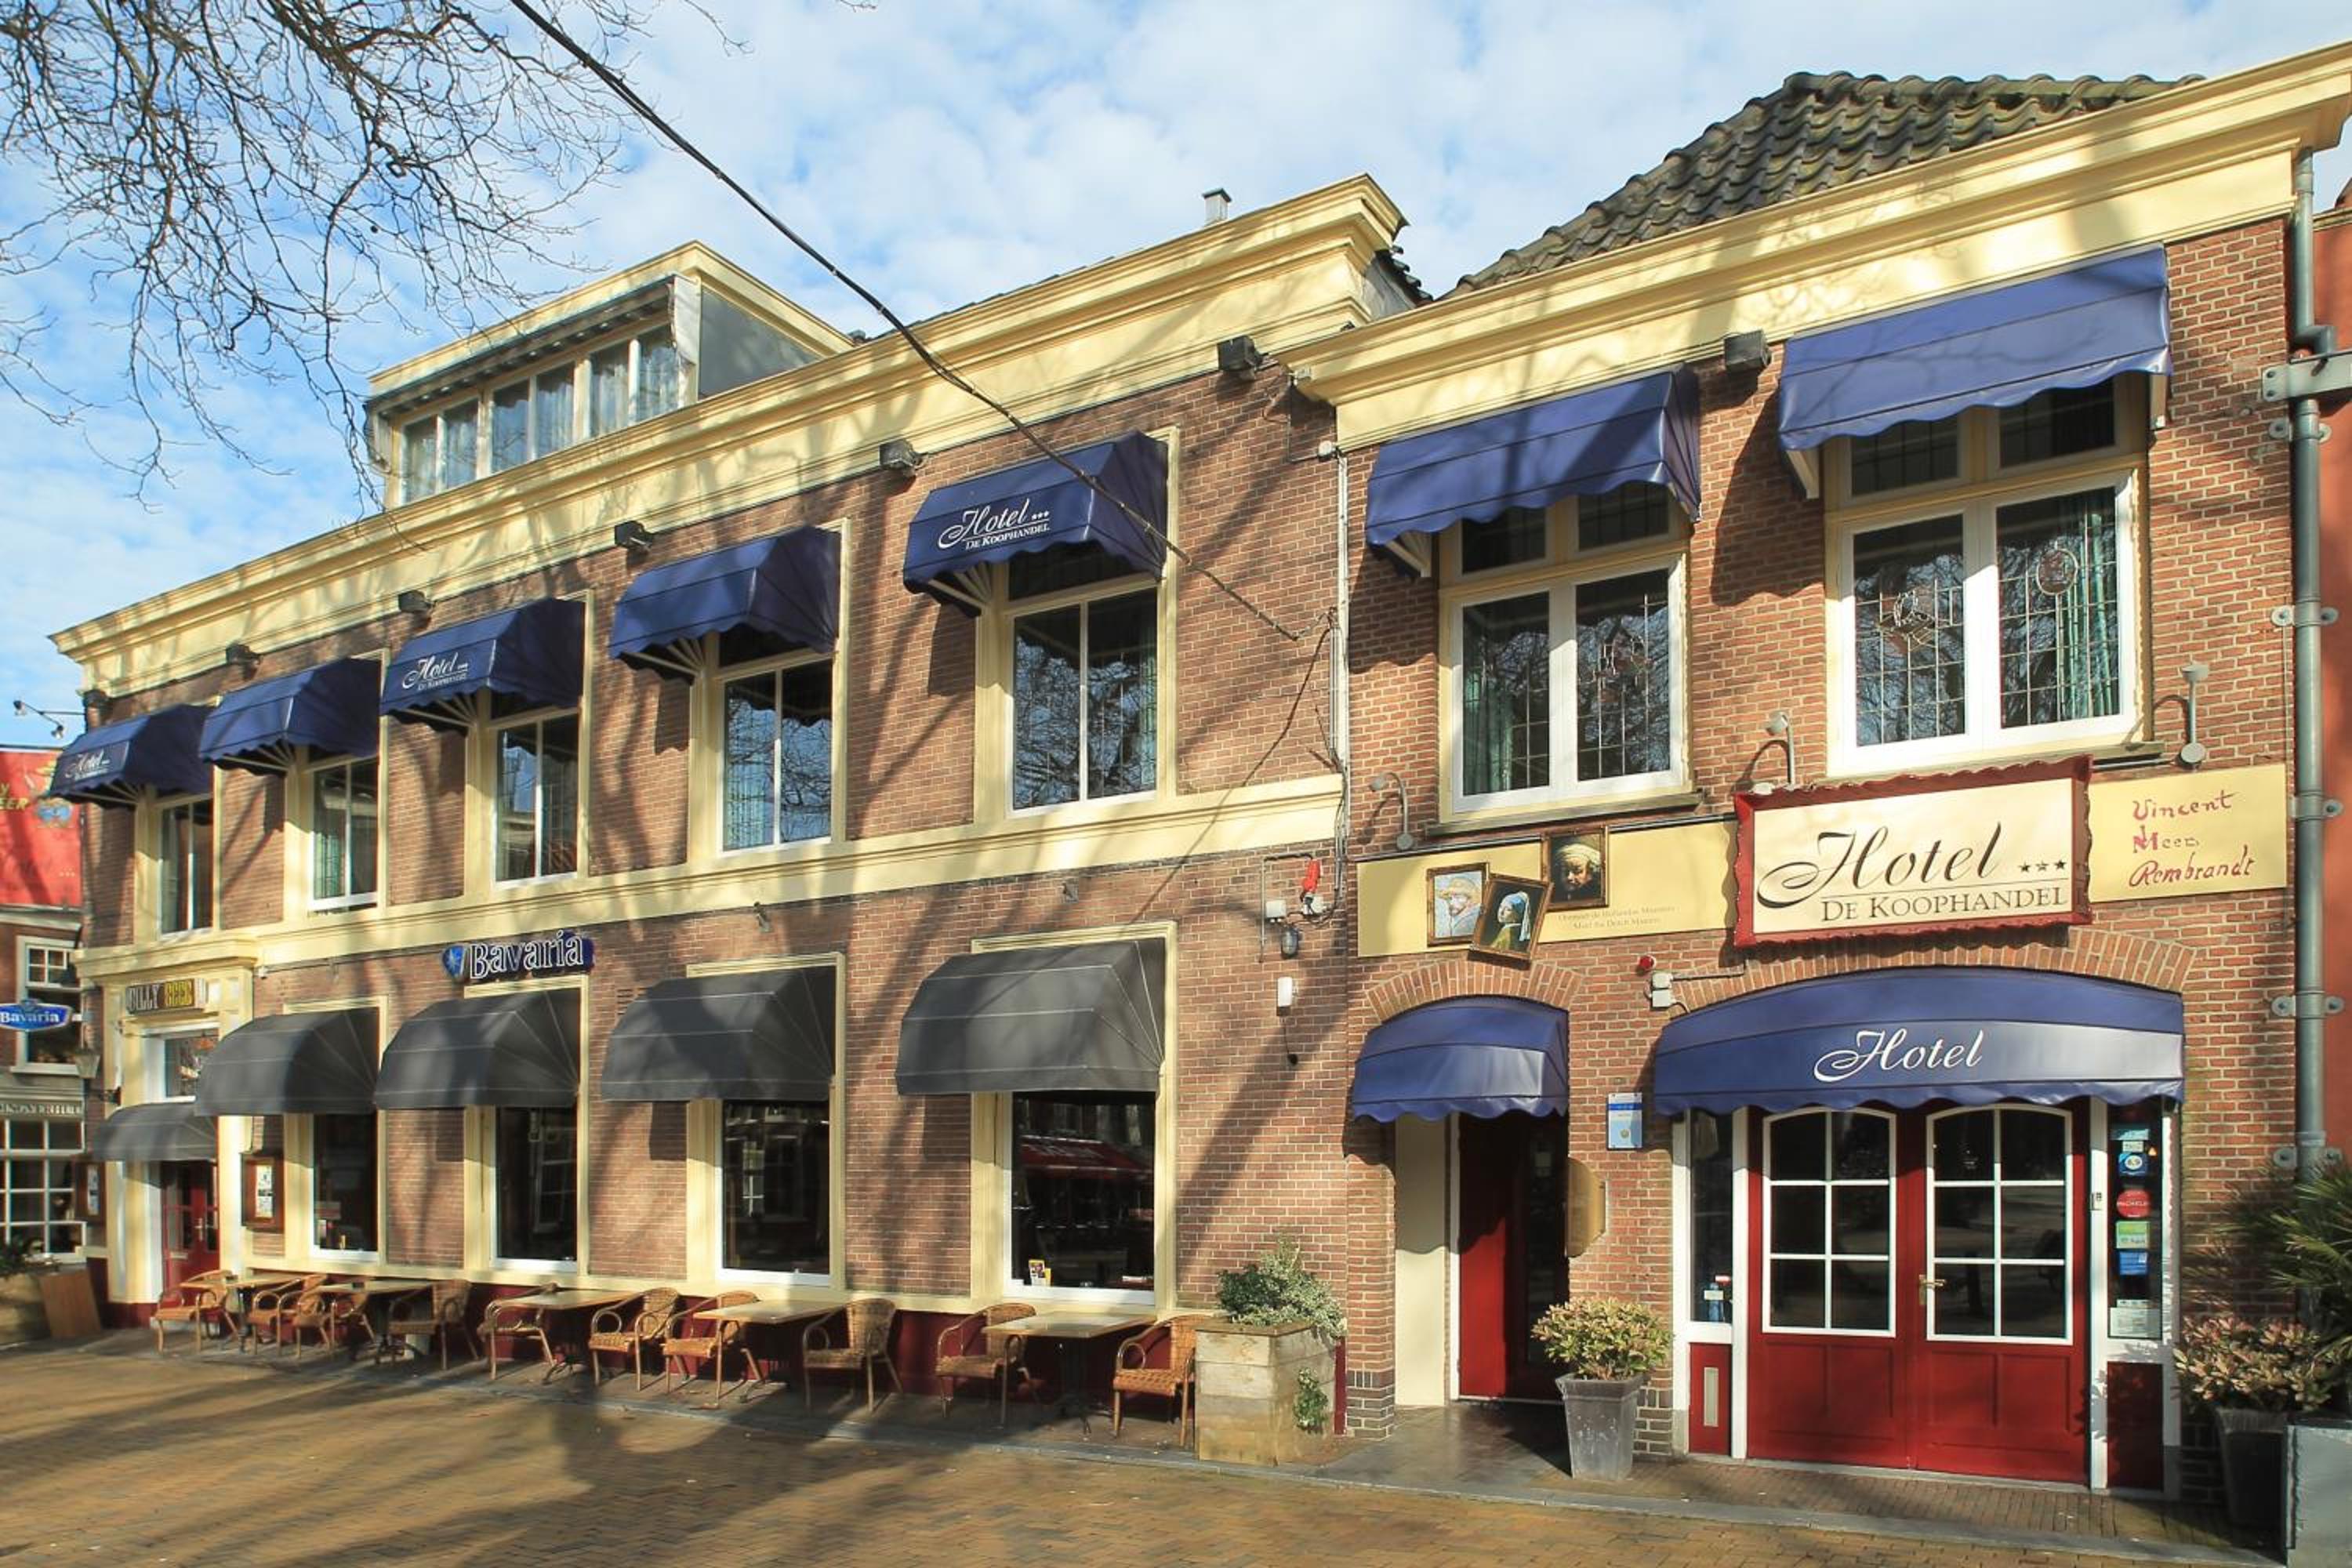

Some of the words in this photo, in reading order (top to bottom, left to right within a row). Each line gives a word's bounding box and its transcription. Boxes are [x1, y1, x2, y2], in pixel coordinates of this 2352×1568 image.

[938, 497, 1031, 549] Hotel
[401, 652, 459, 689] Hotel
[2132, 789, 2239, 821] Vincent
[1756, 820, 2002, 909] Hotel
[2129, 844, 2256, 887] Rembrandt
[1868, 887, 2069, 919] KOOPHANDEL
[470, 929, 584, 979] Bavaria
[0, 1010, 60, 1023] Bavaria
[1813, 1028, 1984, 1083] Hotel
